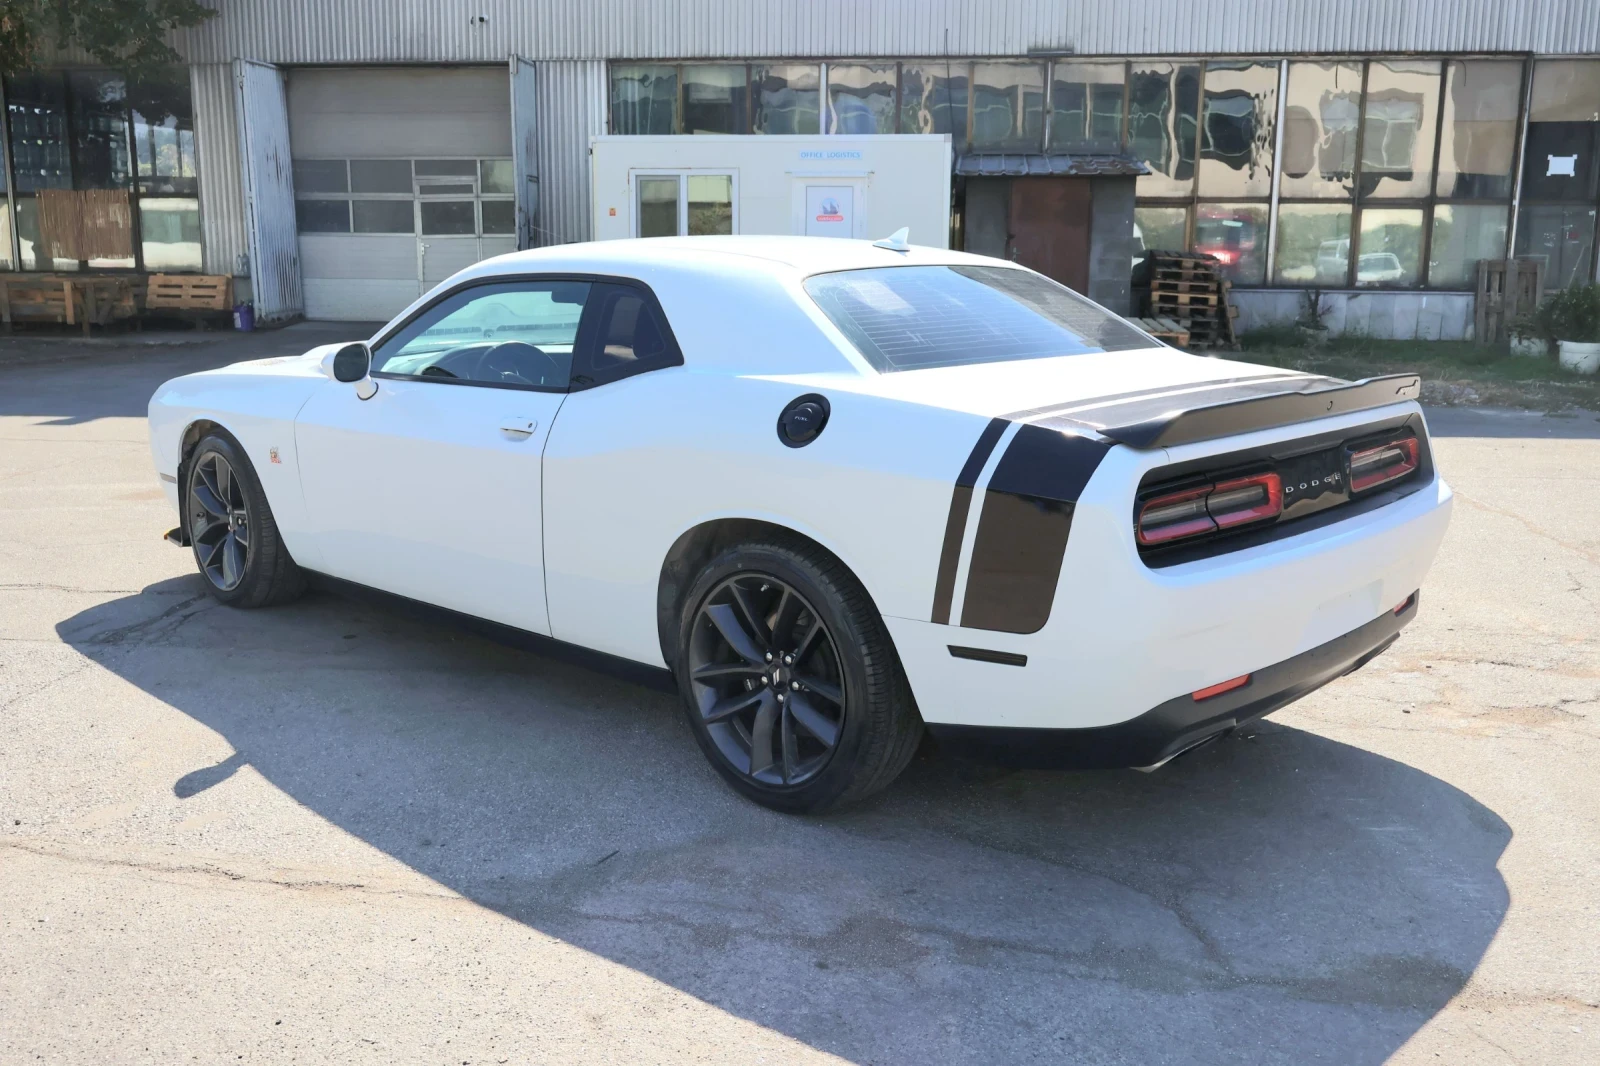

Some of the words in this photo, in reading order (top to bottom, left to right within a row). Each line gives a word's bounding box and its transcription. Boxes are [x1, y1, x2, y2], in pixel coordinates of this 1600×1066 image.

[800, 151, 823, 159] OFFICE
[826, 151, 861, 159] LOGISTICS
[1285, 471, 1341, 493] DODGE
